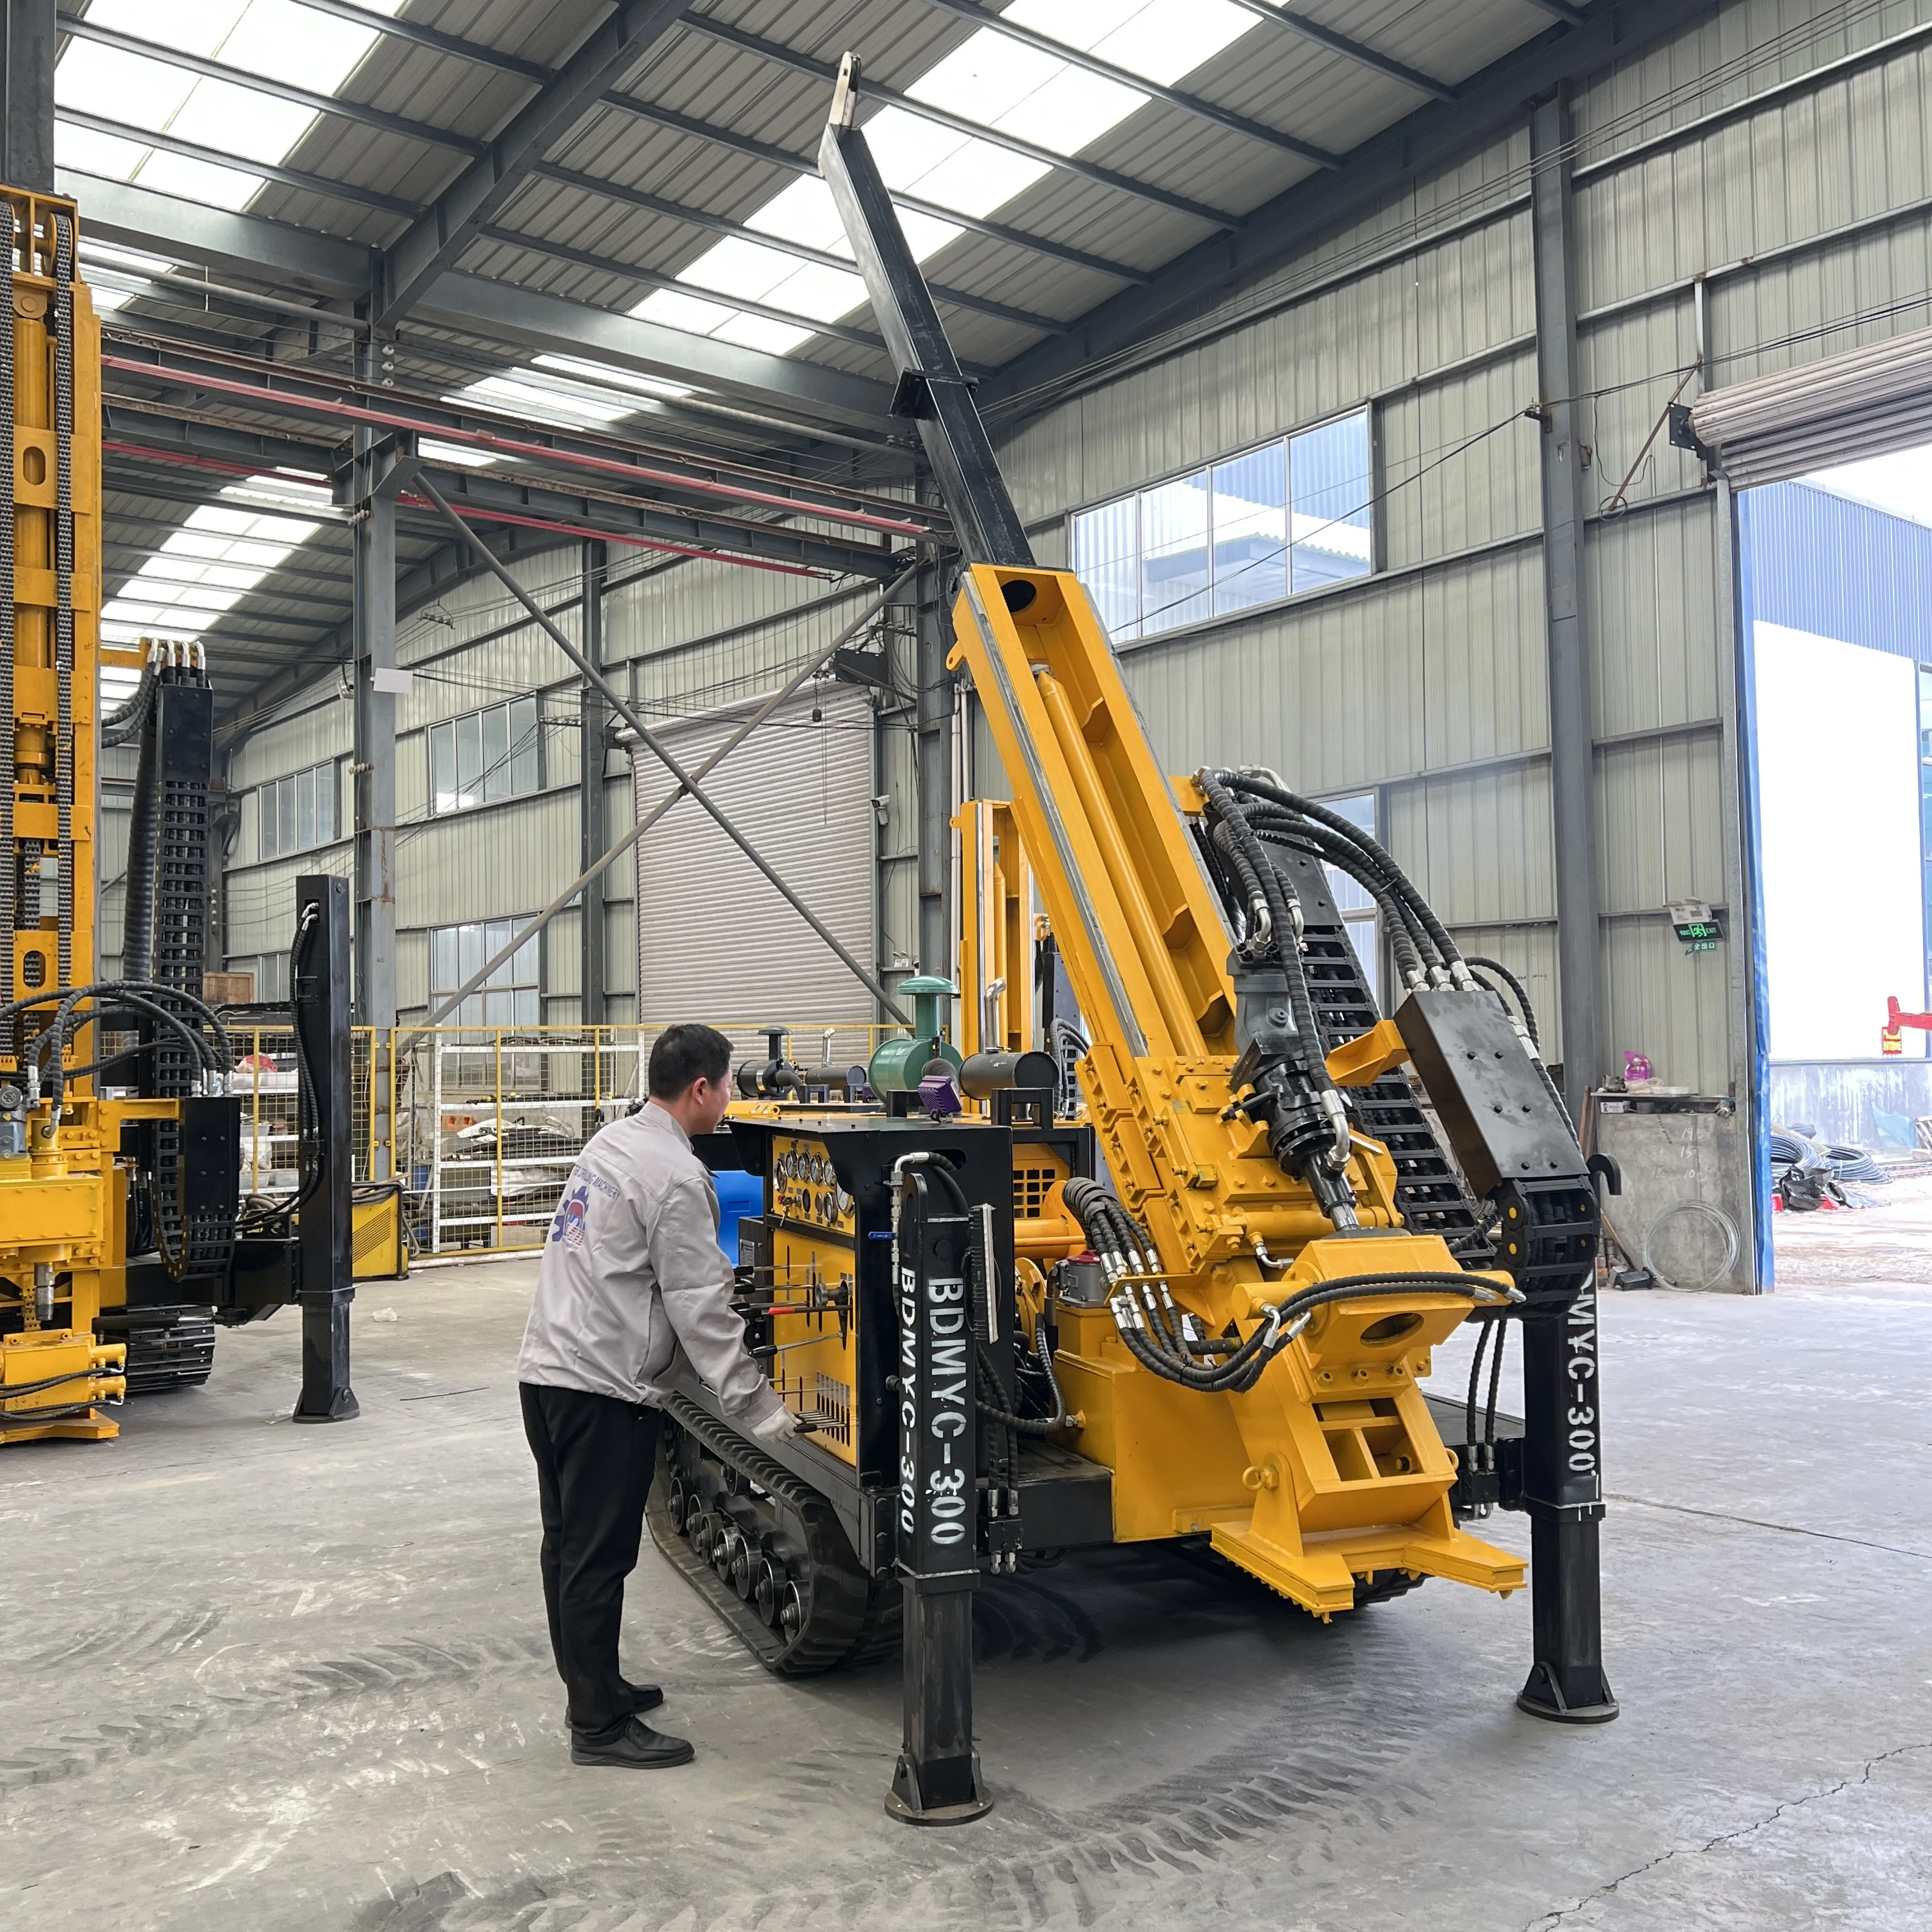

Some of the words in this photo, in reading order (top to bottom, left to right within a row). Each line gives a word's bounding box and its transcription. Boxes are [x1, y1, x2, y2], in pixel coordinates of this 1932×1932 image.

[577, 1167, 597, 1184] DRILLING
[592, 1177, 621, 1200] MACHINERY
[900, 1266, 917, 1535] BDMYC-300
[928, 1278, 967, 1545] BDMYC-300
